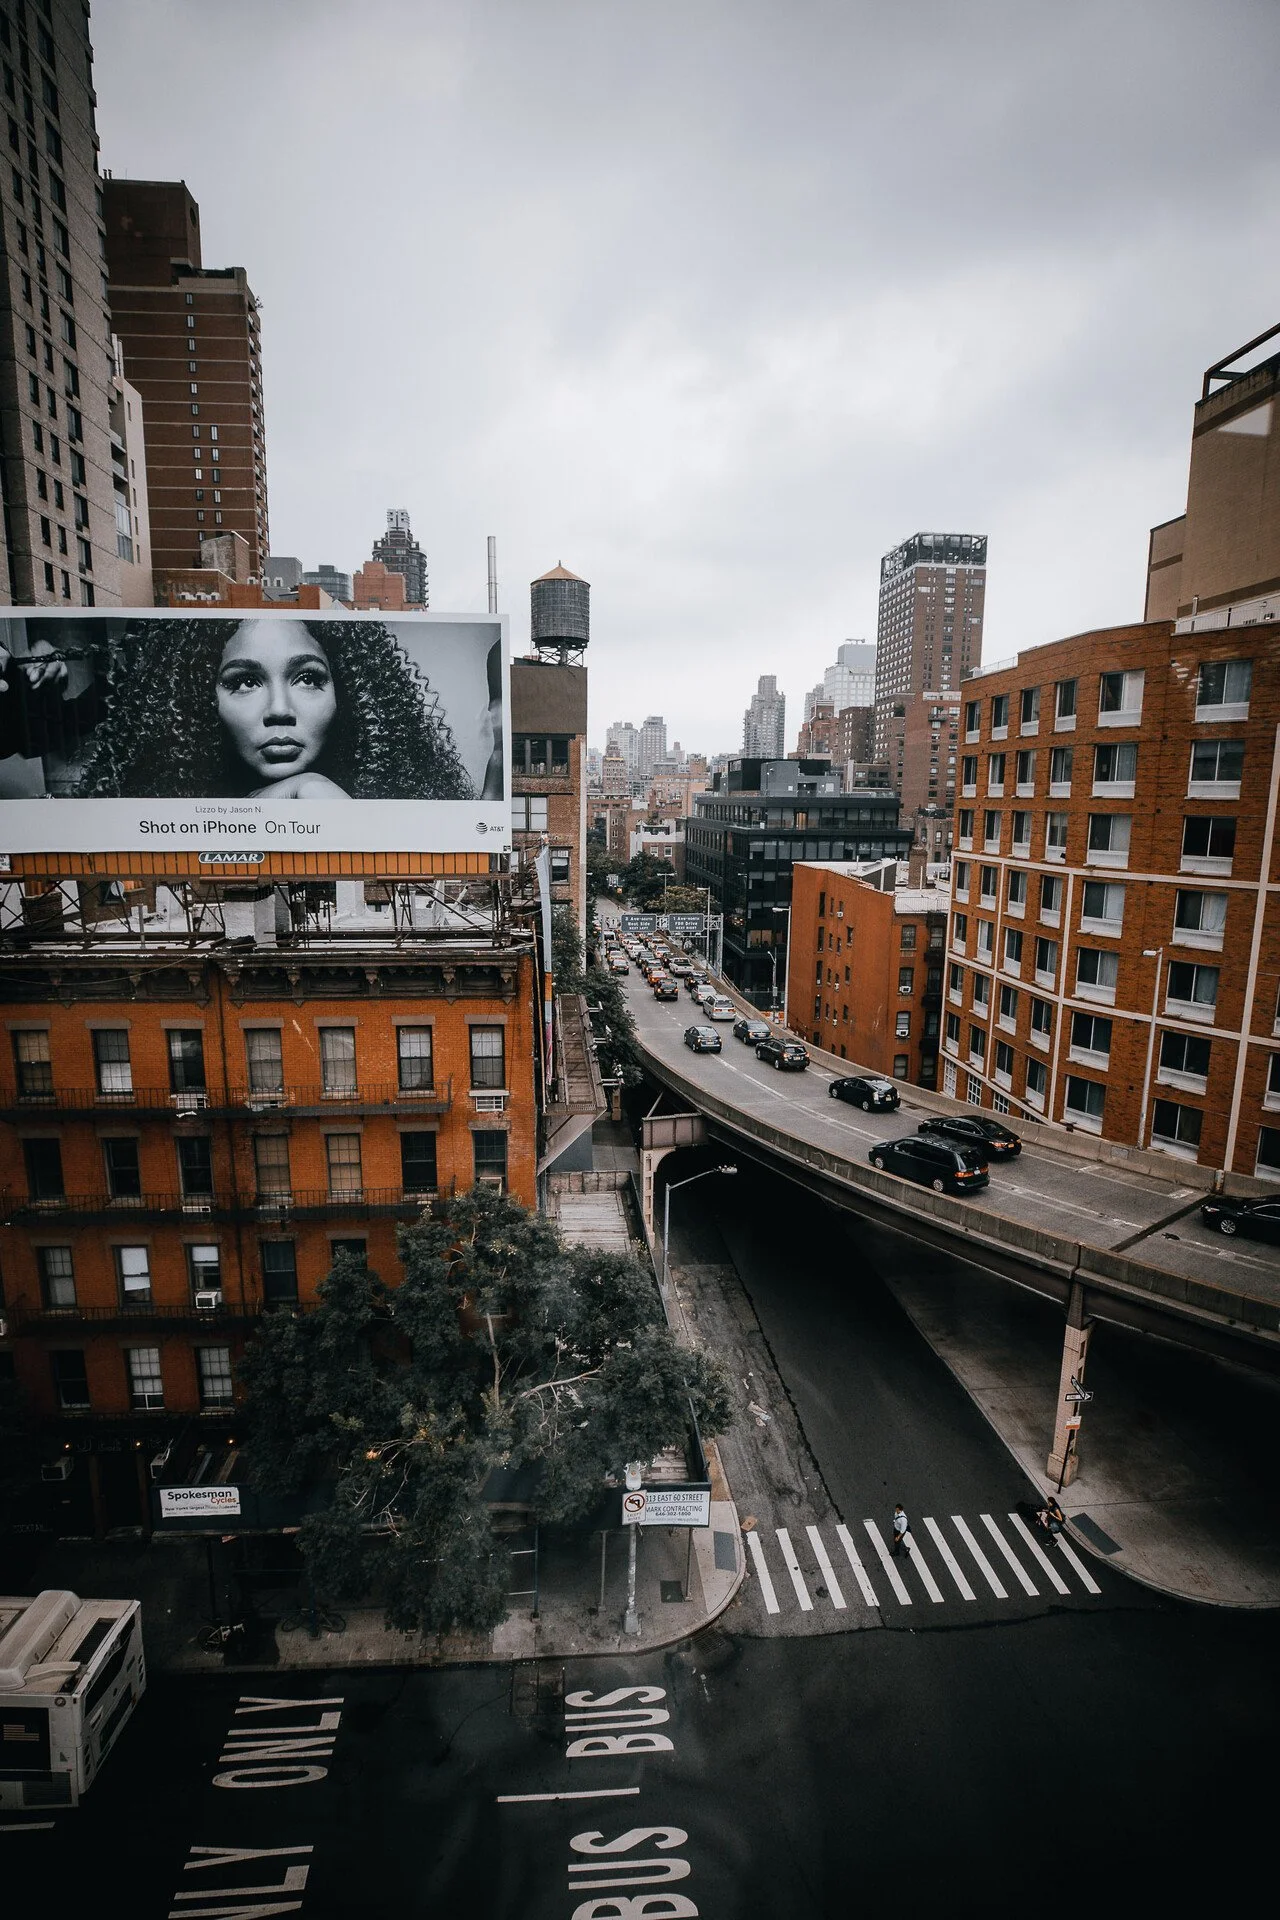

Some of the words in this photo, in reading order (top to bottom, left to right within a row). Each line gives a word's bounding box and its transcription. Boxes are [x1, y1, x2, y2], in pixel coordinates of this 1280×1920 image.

[195, 806, 216, 814] Lizzo
[218, 806, 227, 815] by
[229, 806, 253, 814] Jason
[139, 820, 176, 834] Shot
[179, 823, 199, 834] on
[203, 820, 257, 834] iPhone
[265, 820, 286, 834] On
[289, 821, 321, 834] Tour
[204, 853, 258, 862] LAMAR
[167, 1490, 232, 1501] Spokesman
[211, 1497, 236, 1505] Cycles
[657, 1494, 672, 1502] EAST
[682, 1493, 704, 1501] STREET
[564, 1686, 674, 1758] BUS
[212, 1697, 344, 1789] ONLY
[569, 1826, 699, 1920] BUS
